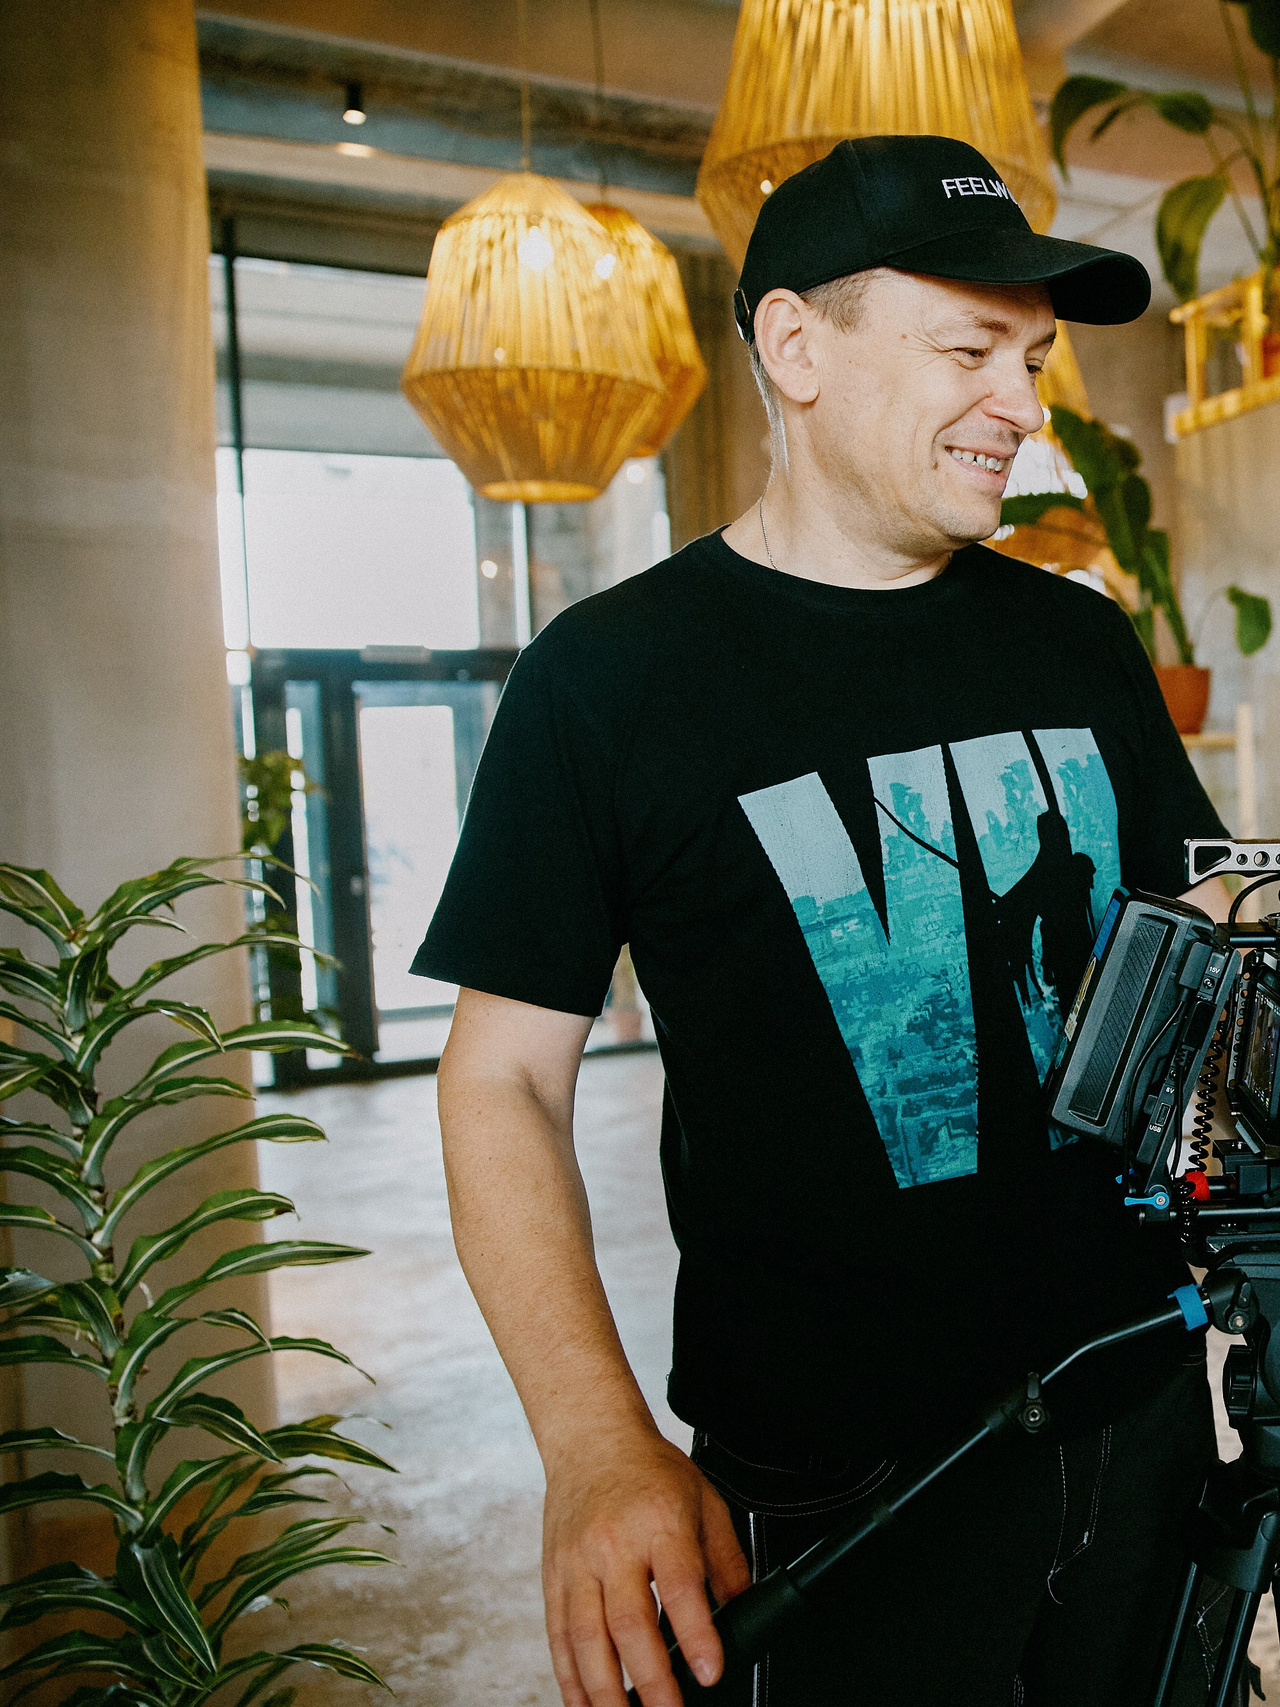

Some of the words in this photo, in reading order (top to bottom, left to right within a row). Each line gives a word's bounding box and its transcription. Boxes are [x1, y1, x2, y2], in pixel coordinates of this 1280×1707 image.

[941, 177, 1020, 208] FEELW
[1209, 965, 1221, 974] 15V
[1149, 1124, 1162, 1133] USB
